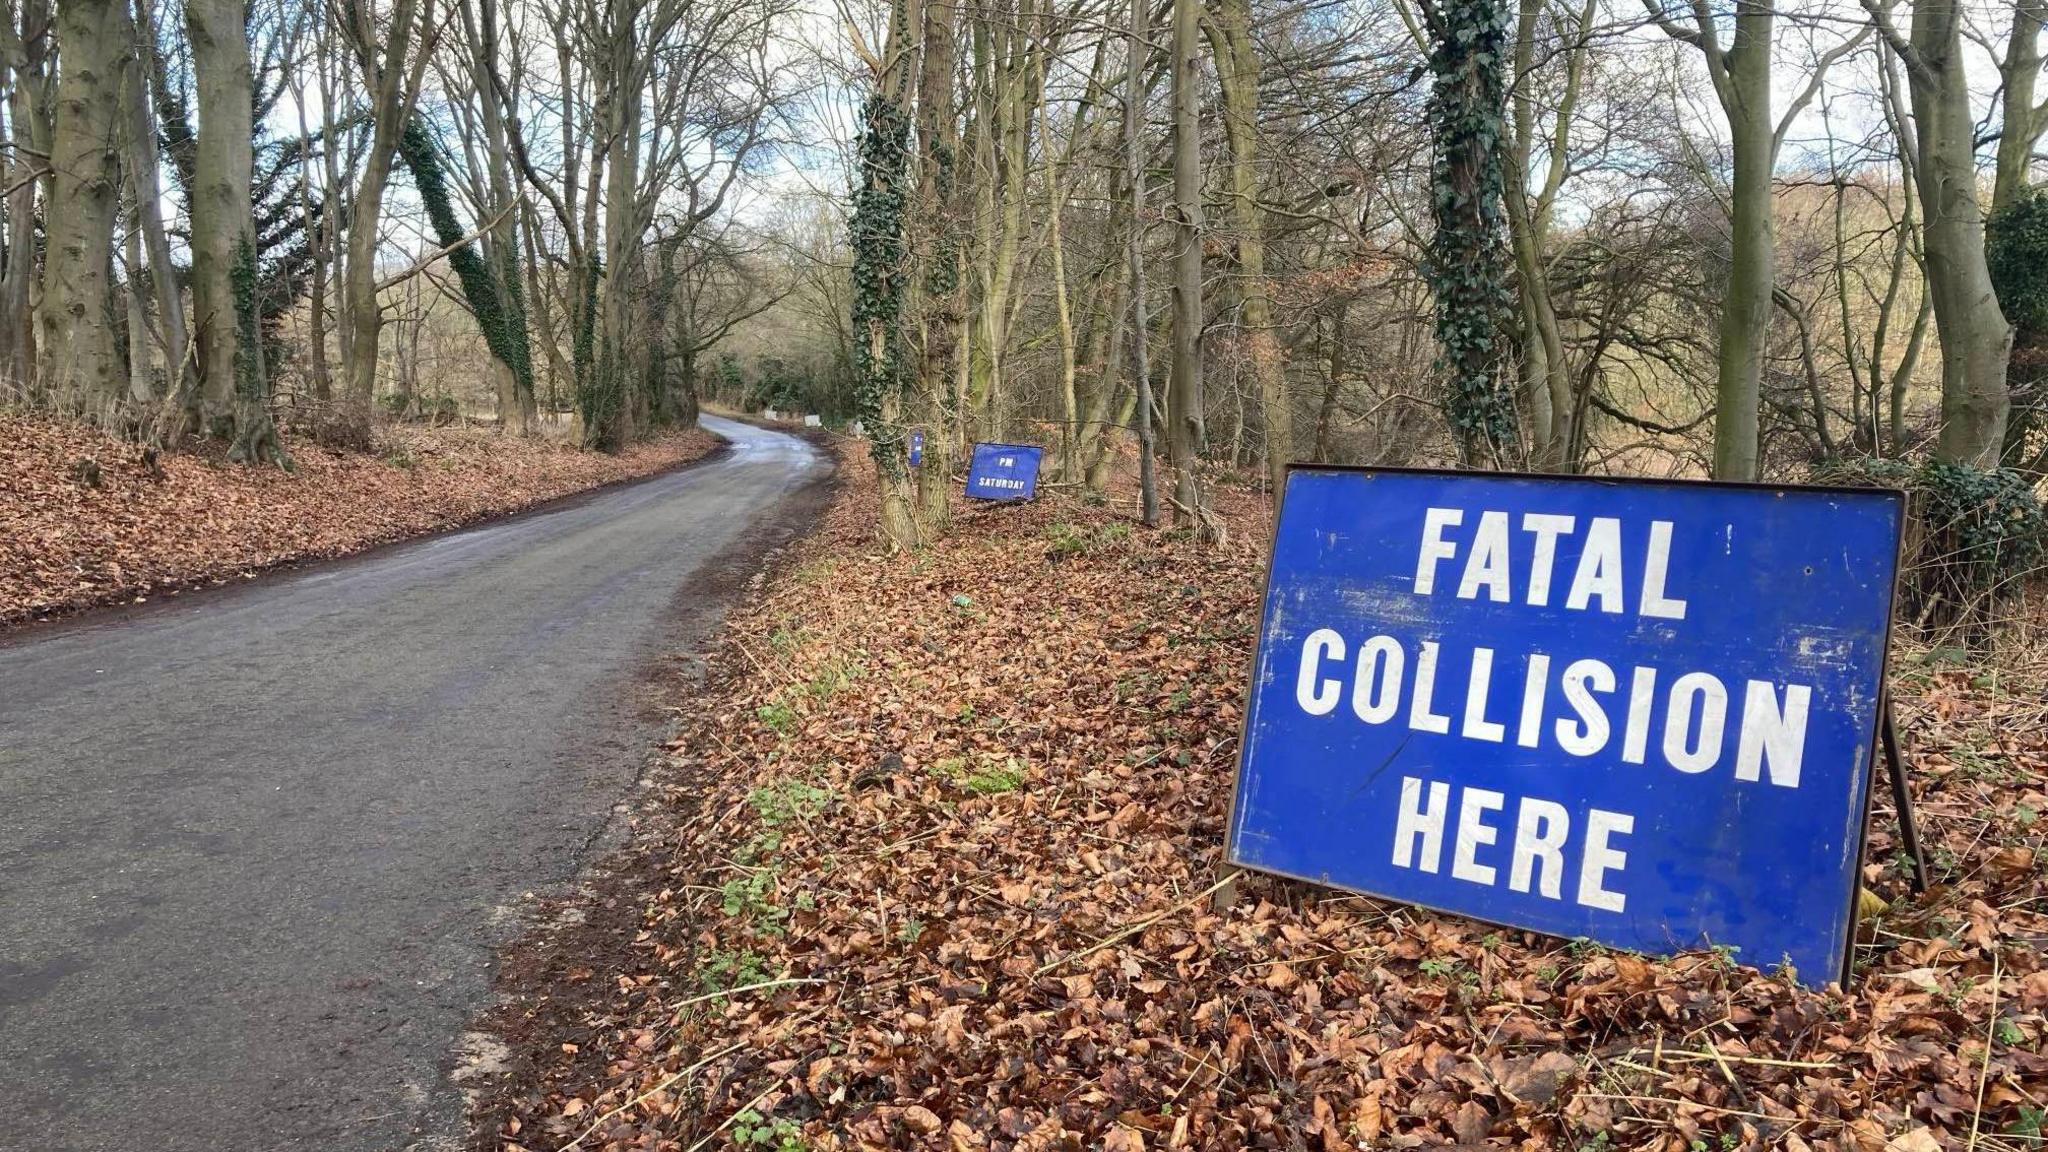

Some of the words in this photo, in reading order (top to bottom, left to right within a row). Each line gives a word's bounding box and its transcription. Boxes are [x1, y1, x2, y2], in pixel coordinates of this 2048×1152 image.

[978, 477, 1025, 490] SATURDAY
[999, 457, 1014, 467] PM
[1413, 507, 1686, 621] FATAL
[1296, 628, 1812, 788] COLLISION
[1391, 776, 1634, 913] HERE
